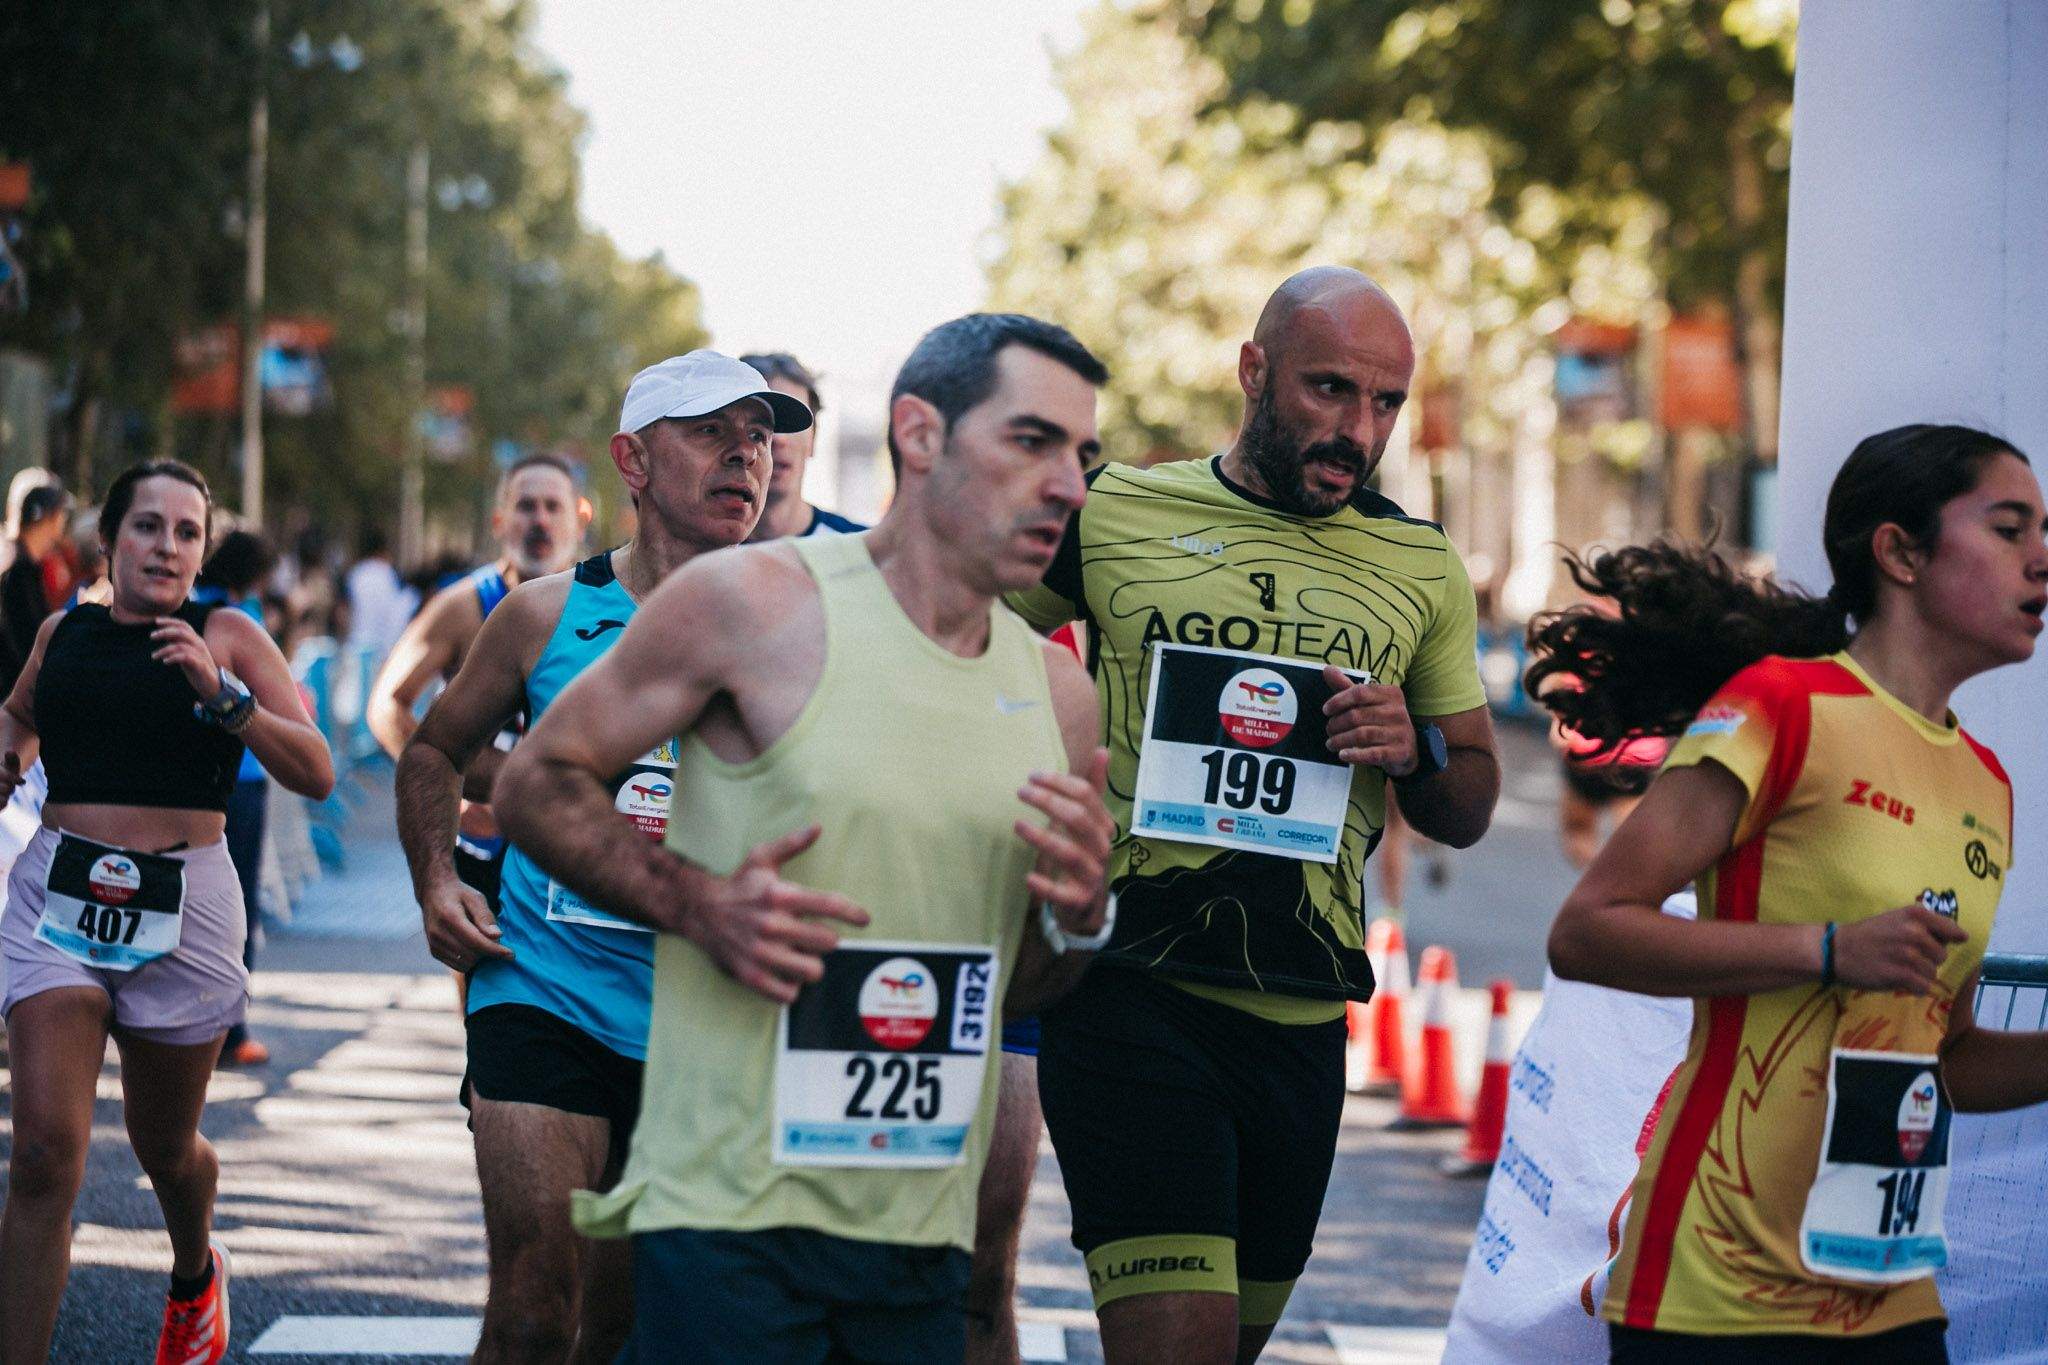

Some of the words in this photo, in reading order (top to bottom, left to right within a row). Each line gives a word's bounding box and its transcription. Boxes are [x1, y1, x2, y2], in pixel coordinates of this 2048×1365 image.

[1231, 725, 1245, 735] DE
[1245, 727, 1279, 739] MADRID
[1243, 718, 1269, 730] MILLA
[1201, 749, 1297, 816] 199
[1843, 779, 1915, 827] Zeus
[636, 817, 660, 826] MILLA
[1161, 812, 1206, 827] MADRID
[77, 903, 142, 946] 407
[960, 962, 990, 1040] 3192
[845, 1057, 941, 1120] 225
[1877, 1170, 1927, 1236] 194
[1107, 1255, 1215, 1281] LURBEL
